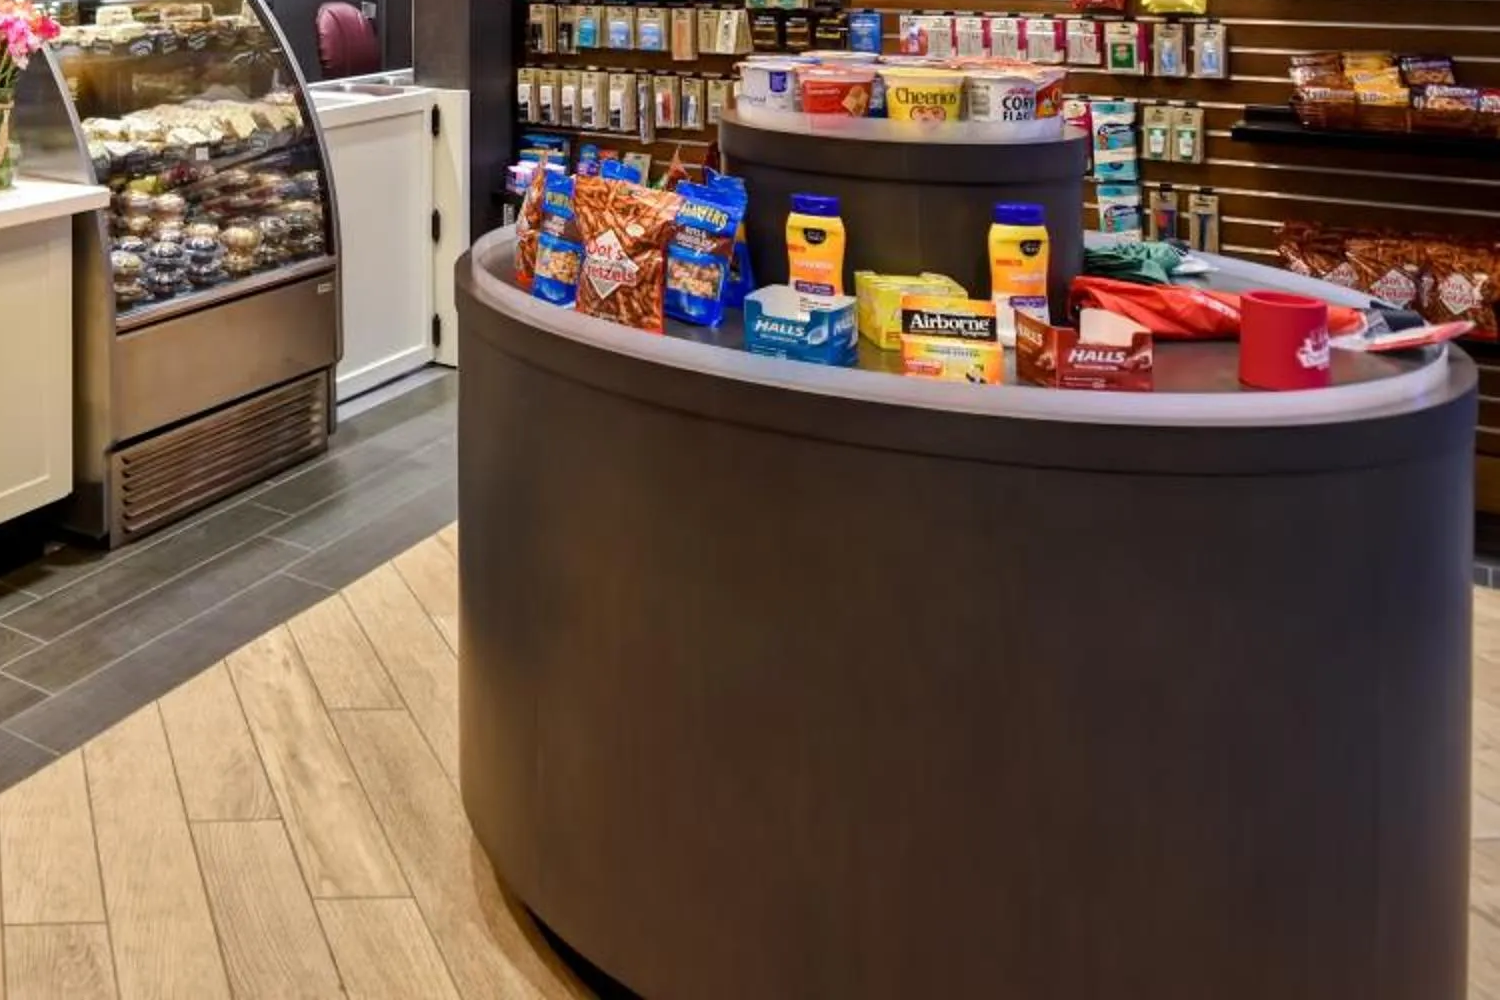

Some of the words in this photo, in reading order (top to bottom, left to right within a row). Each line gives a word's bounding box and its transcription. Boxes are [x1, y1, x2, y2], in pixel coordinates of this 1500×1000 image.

[755, 319, 805, 337] HALLS
[909, 313, 990, 331] Airborne
[1067, 348, 1126, 364] HALLS
